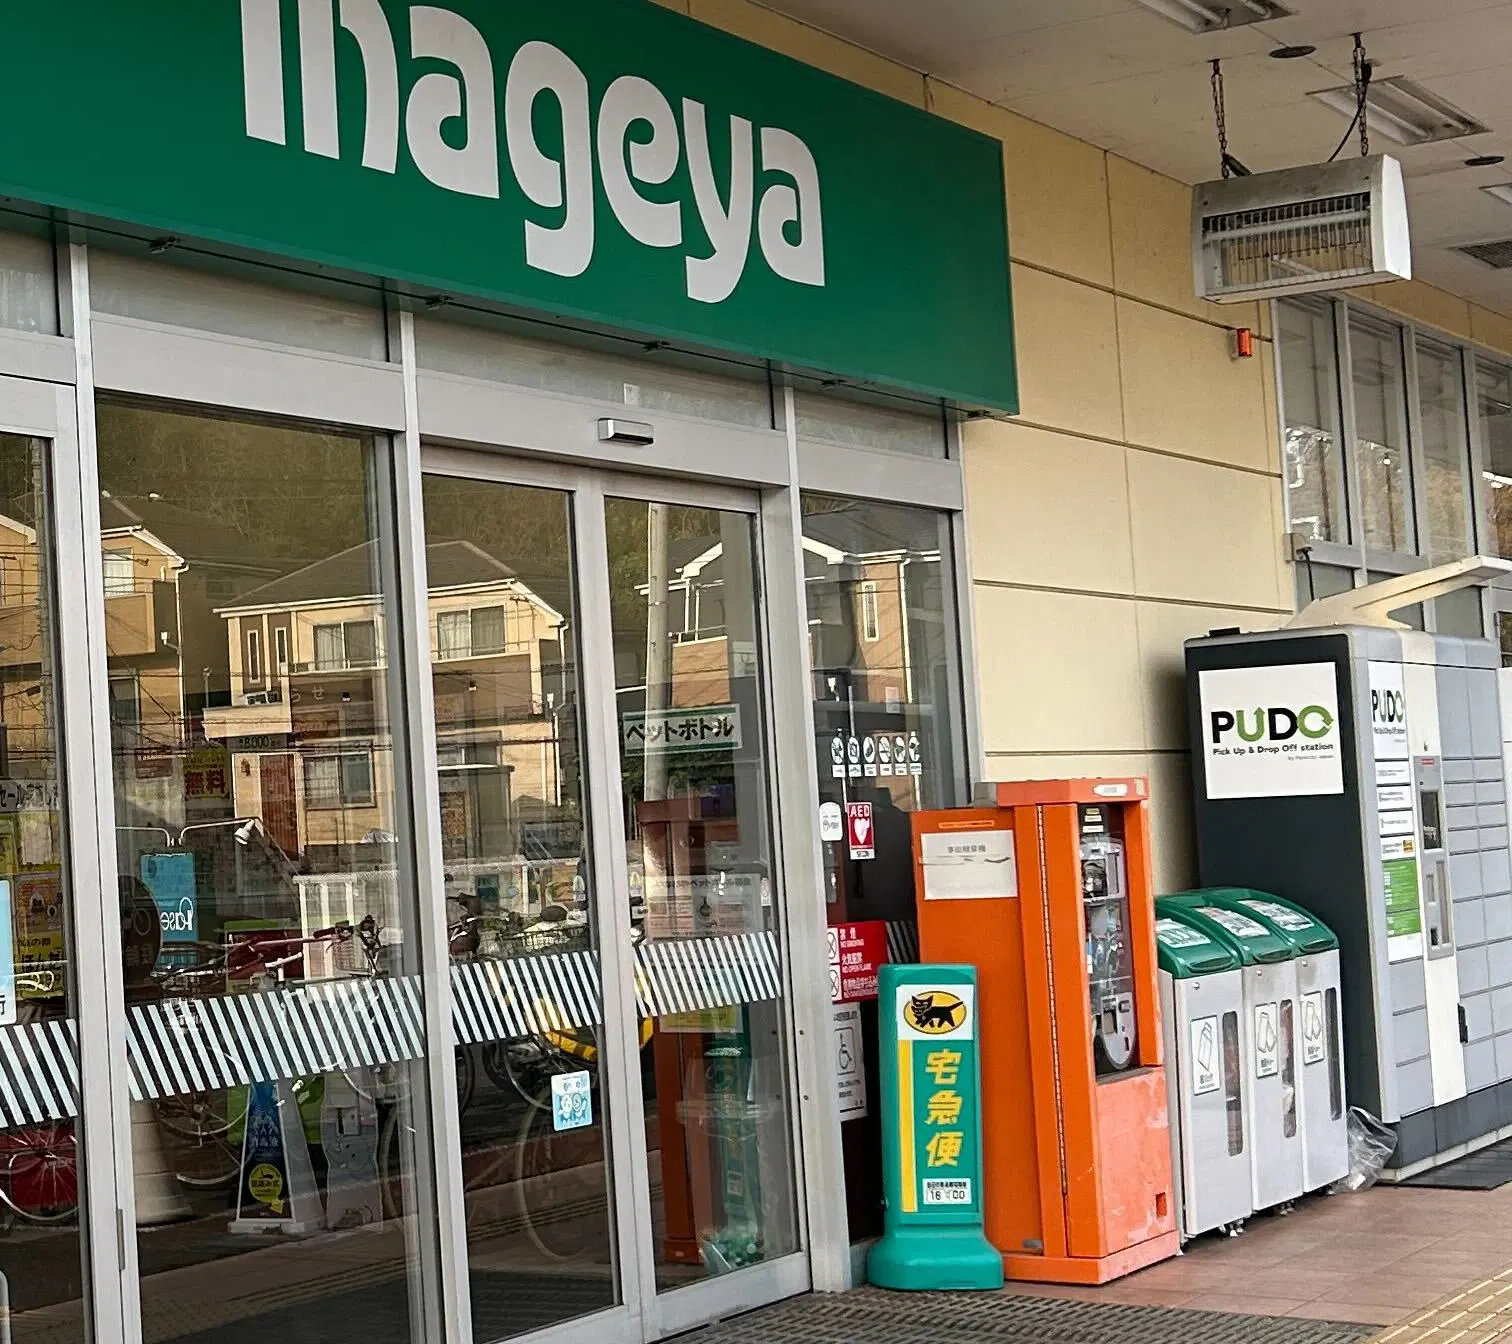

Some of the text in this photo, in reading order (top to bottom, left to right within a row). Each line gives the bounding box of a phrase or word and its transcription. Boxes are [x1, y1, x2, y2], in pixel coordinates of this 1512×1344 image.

[1371, 689, 1404, 723] PUDO
[626, 716, 735, 743] ペットボトル
[1211, 705, 1334, 744] PUDO
[1212, 742, 1334, 756] Pick Up & Drop Off station
[850, 804, 870, 817] AED
[925, 1048, 965, 1168] 宅急便
